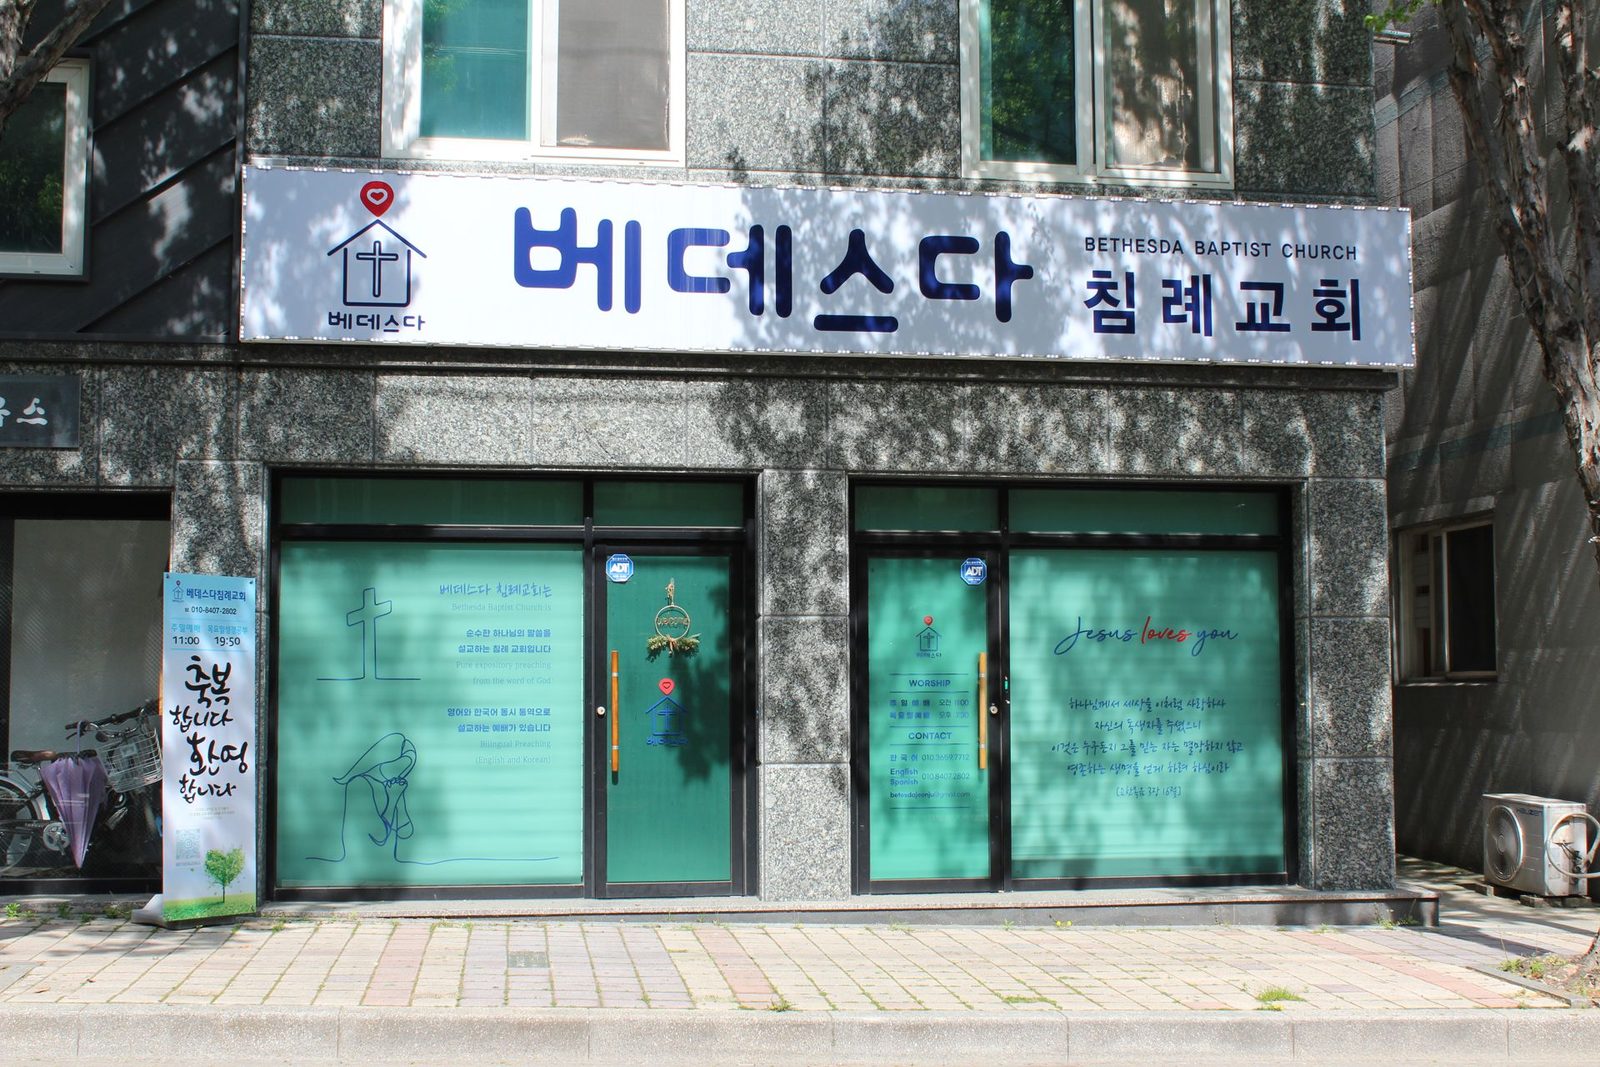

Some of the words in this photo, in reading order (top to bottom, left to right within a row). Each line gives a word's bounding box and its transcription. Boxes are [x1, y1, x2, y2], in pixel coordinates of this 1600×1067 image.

[1085, 237, 1184, 254] BETHESDA
[1195, 241, 1271, 258] BAPTIST
[1281, 243, 1357, 260] CHURCH
[514, 206, 1034, 332] 베데스다
[328, 311, 426, 332] 베데스다
[610, 562, 630, 573] ADT
[965, 566, 983, 577] ADT
[186, 588, 246, 601] 베데스다침례교회
[439, 583, 491, 596] 베데스다
[496, 582, 552, 598] 침례교회는
[191, 606, 237, 615] 010-8407-2802
[466, 629, 490, 638] 순수한
[493, 629, 525, 638] 하나님의
[1054, 616, 1138, 656] Jesus
[1141, 616, 1192, 645] loves
[1191, 626, 1239, 656] you
[173, 636, 200, 645] 11:00
[215, 637, 241, 647] 19:50
[458, 645, 490, 653] 설교하는
[493, 645, 509, 653] 침례
[511, 645, 551, 653] 교회입니다
[185, 655, 232, 708] 축복
[492, 677, 505, 685] the
[506, 677, 524, 685] word
[1069, 697, 1120, 710] 하나님께서
[1123, 697, 1152, 712] 세상을
[1187, 696, 1227, 711] 사랑하사
[447, 708, 471, 717] 영어와
[474, 708, 498, 717] 한국어
[501, 708, 516, 717] 동시
[169, 705, 233, 733] 합니다
[458, 724, 490, 733] 설교하는
[492, 724, 516, 733] 예배가
[519, 724, 551, 733] 있습니다
[1095, 721, 1123, 732] 자신의
[908, 732, 952, 740] CONTACT
[187, 732, 248, 776] 환영
[1052, 741, 1079, 755] 이것은
[1083, 741, 1117, 756] 누구든지
[890, 768, 918, 777] English
[1110, 762, 1140, 777] 생명을
[890, 778, 918, 787] Spanish
[179, 774, 236, 804] 합니다
